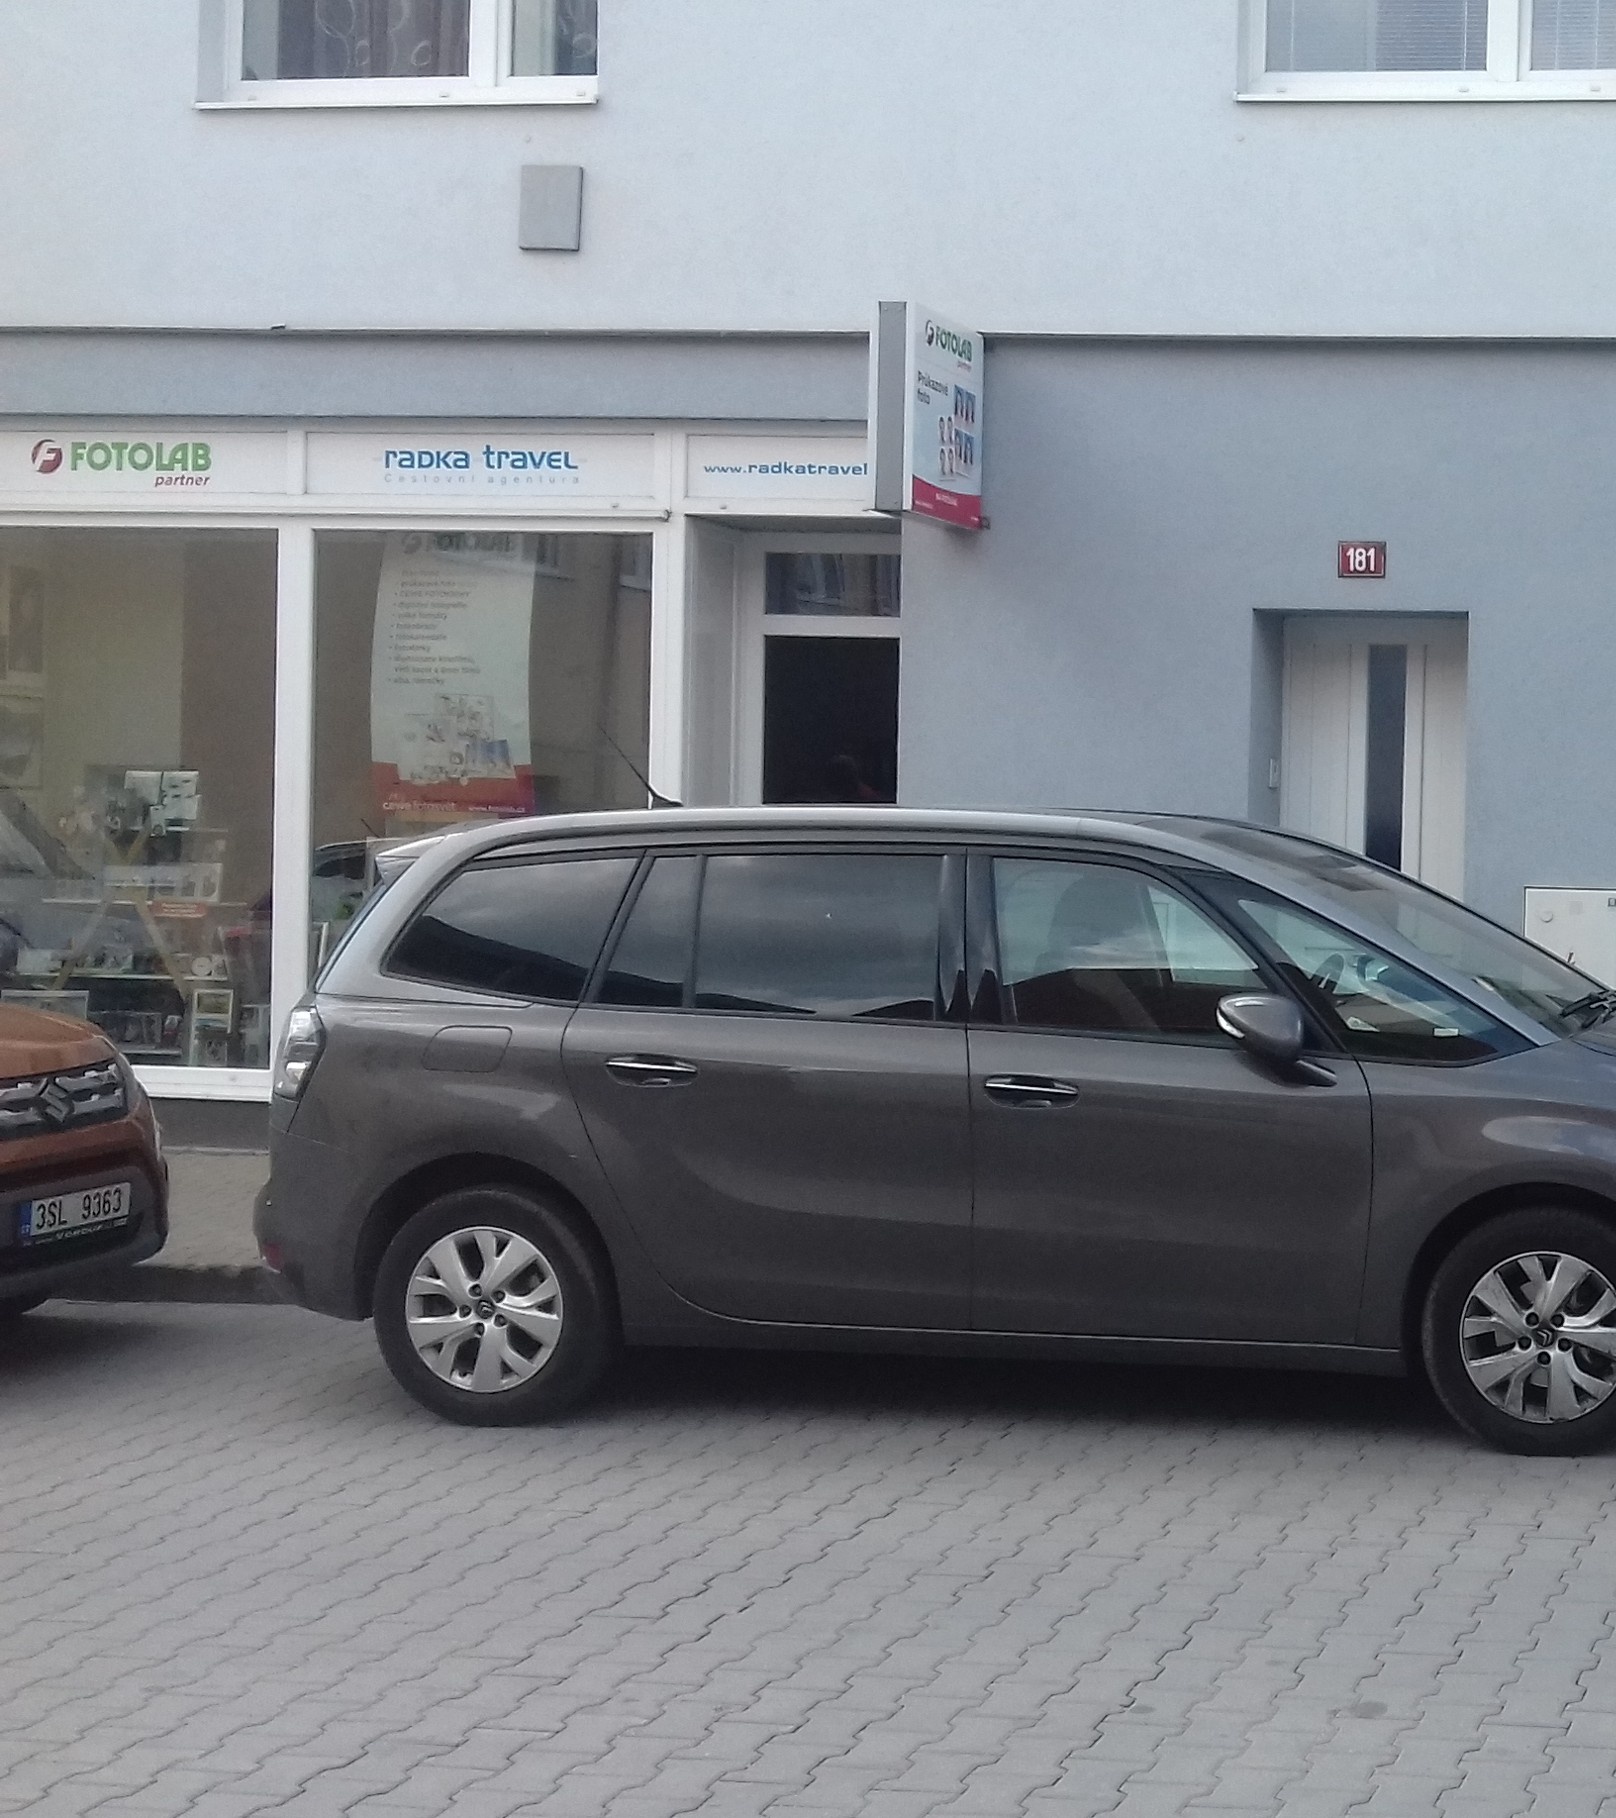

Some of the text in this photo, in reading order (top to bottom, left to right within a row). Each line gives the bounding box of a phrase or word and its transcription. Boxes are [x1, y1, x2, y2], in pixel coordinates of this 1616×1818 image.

[935, 325, 973, 363] FOTOLAB
[70, 441, 212, 471] FOTOLAB
[155, 474, 210, 488] partner
[1346, 547, 1376, 573] 181
[36, 1187, 122, 1230] 3SL 9363
